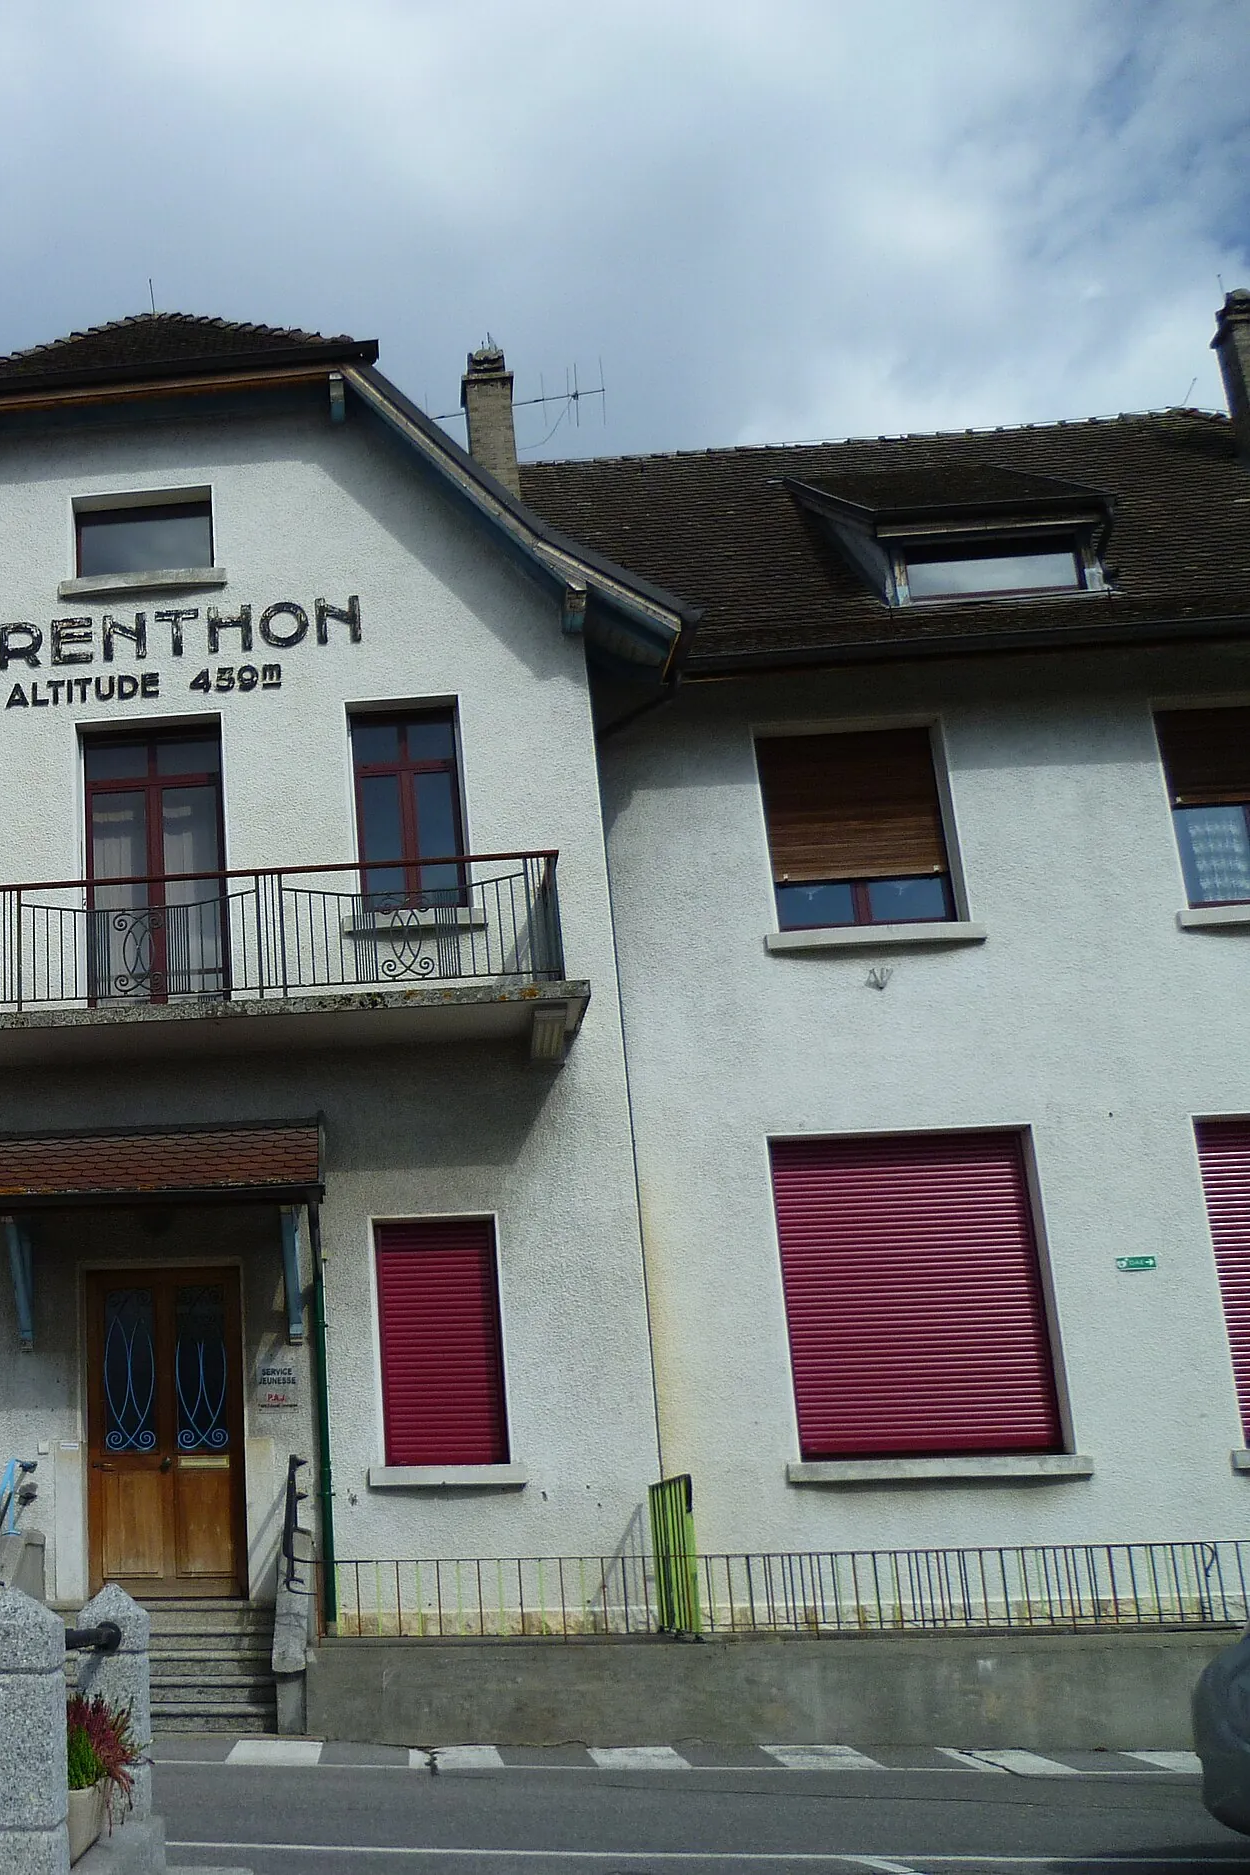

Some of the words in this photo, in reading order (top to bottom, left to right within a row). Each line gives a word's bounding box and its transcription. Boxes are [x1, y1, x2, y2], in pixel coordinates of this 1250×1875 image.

[5, 672, 160, 709] ALTITUDE
[261, 1367, 293, 1376] SERVICE
[258, 1376, 297, 1385] JEUNESSE
